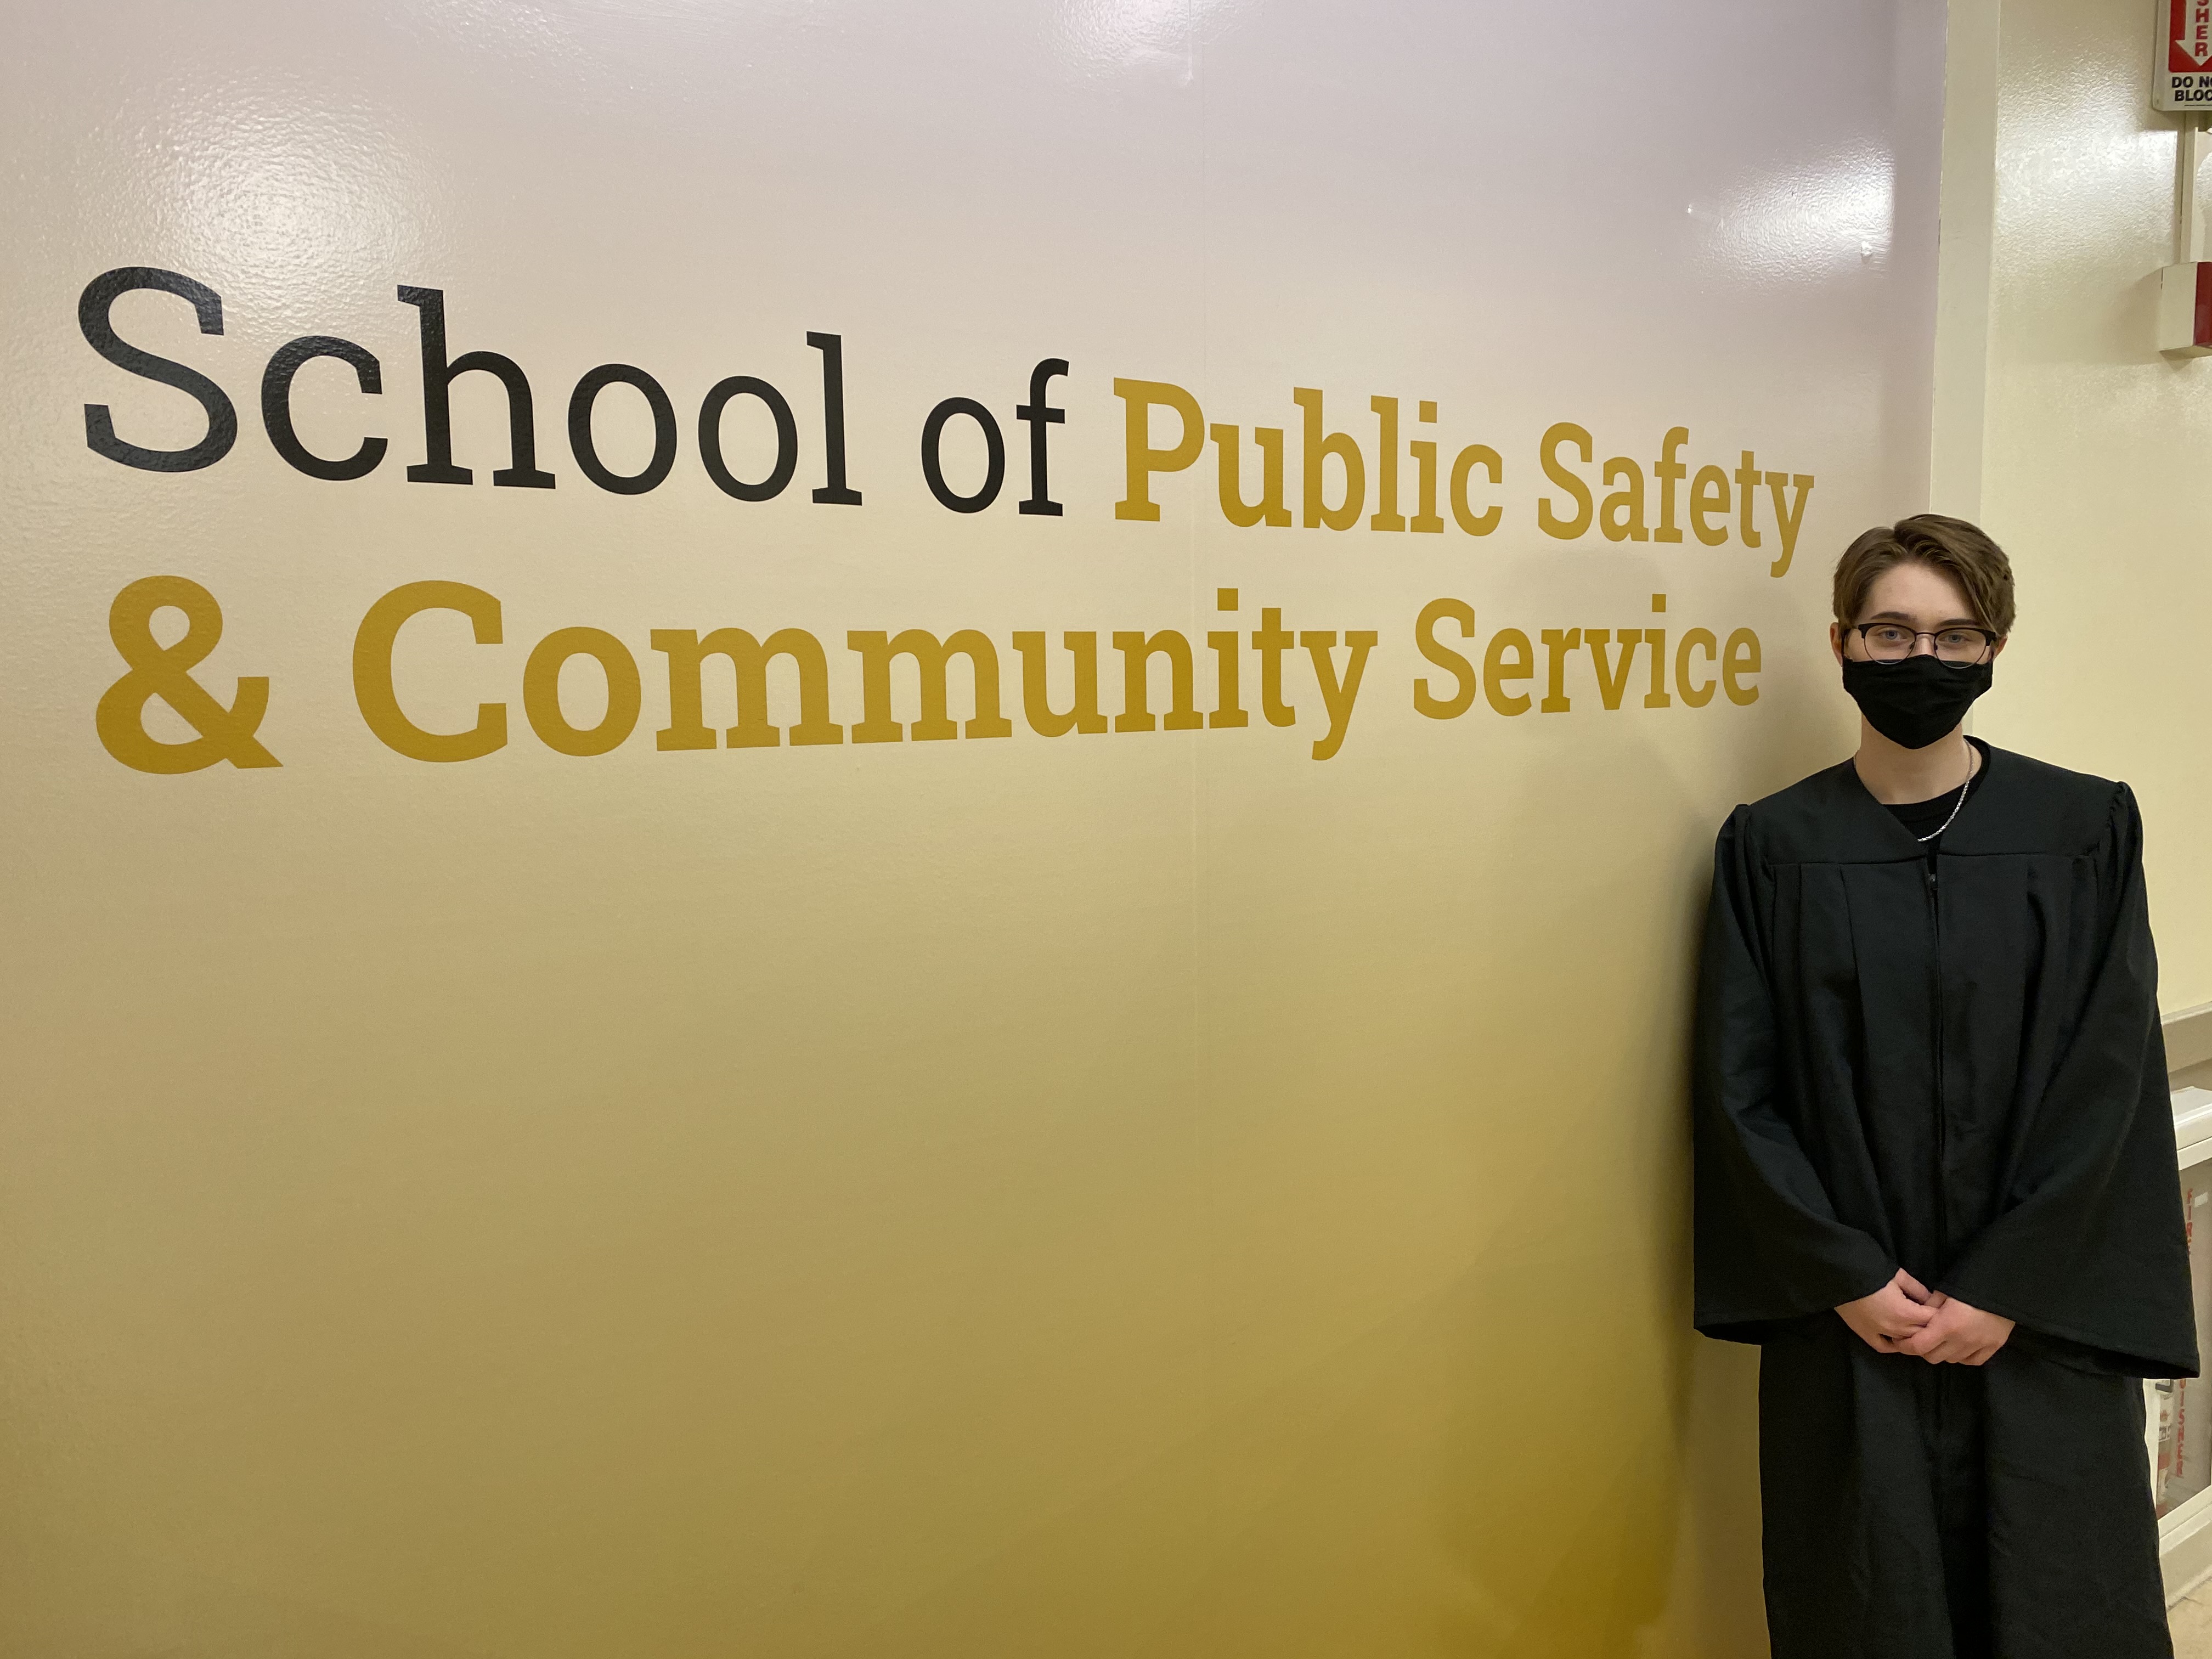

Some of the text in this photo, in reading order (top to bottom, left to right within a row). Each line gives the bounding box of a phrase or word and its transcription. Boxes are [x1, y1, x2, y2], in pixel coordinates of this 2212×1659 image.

[2172, 76, 2212, 88] DO N
[77, 266, 1815, 578] School of Public Safety
[95, 574, 1762, 775] & Community Service
